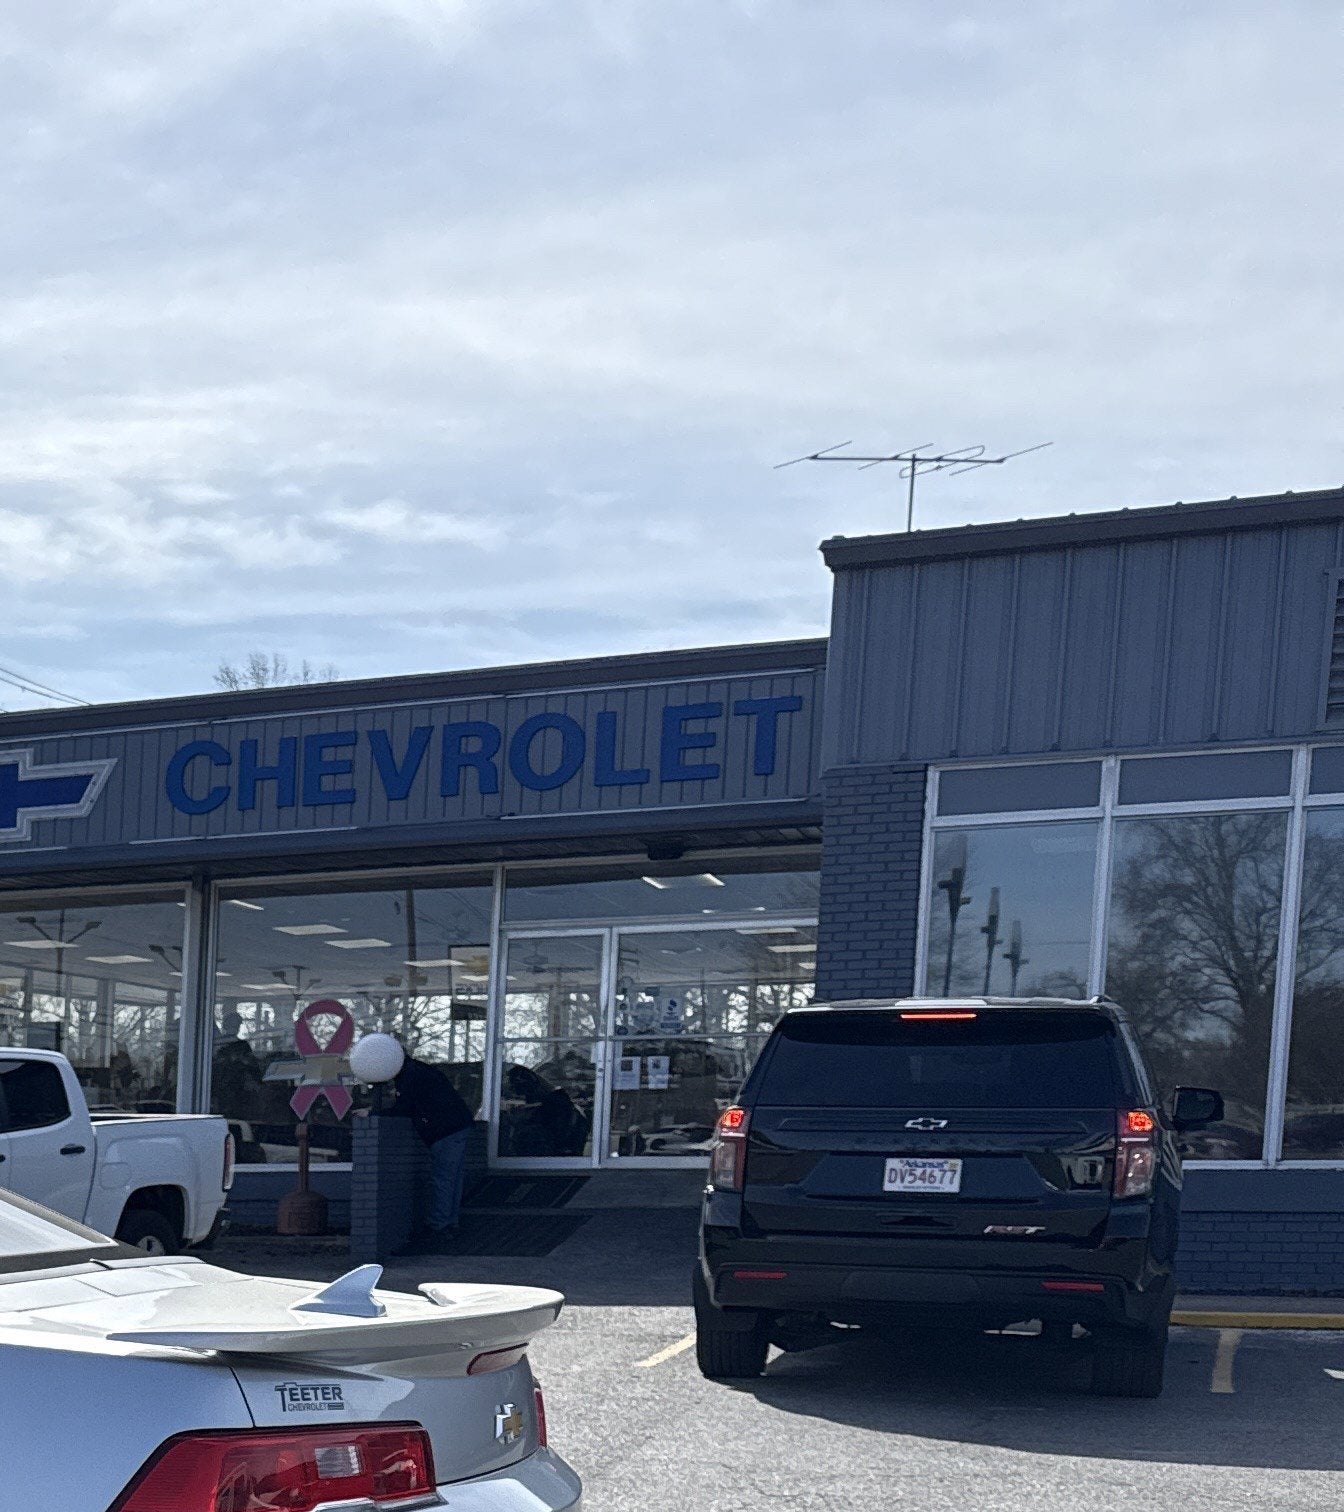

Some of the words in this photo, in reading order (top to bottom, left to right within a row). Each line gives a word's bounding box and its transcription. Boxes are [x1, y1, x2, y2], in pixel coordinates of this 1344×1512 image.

[165, 695, 803, 816] CHEVROLET
[887, 1168, 958, 1185] DV54677
[275, 1384, 344, 1412] TEETER
